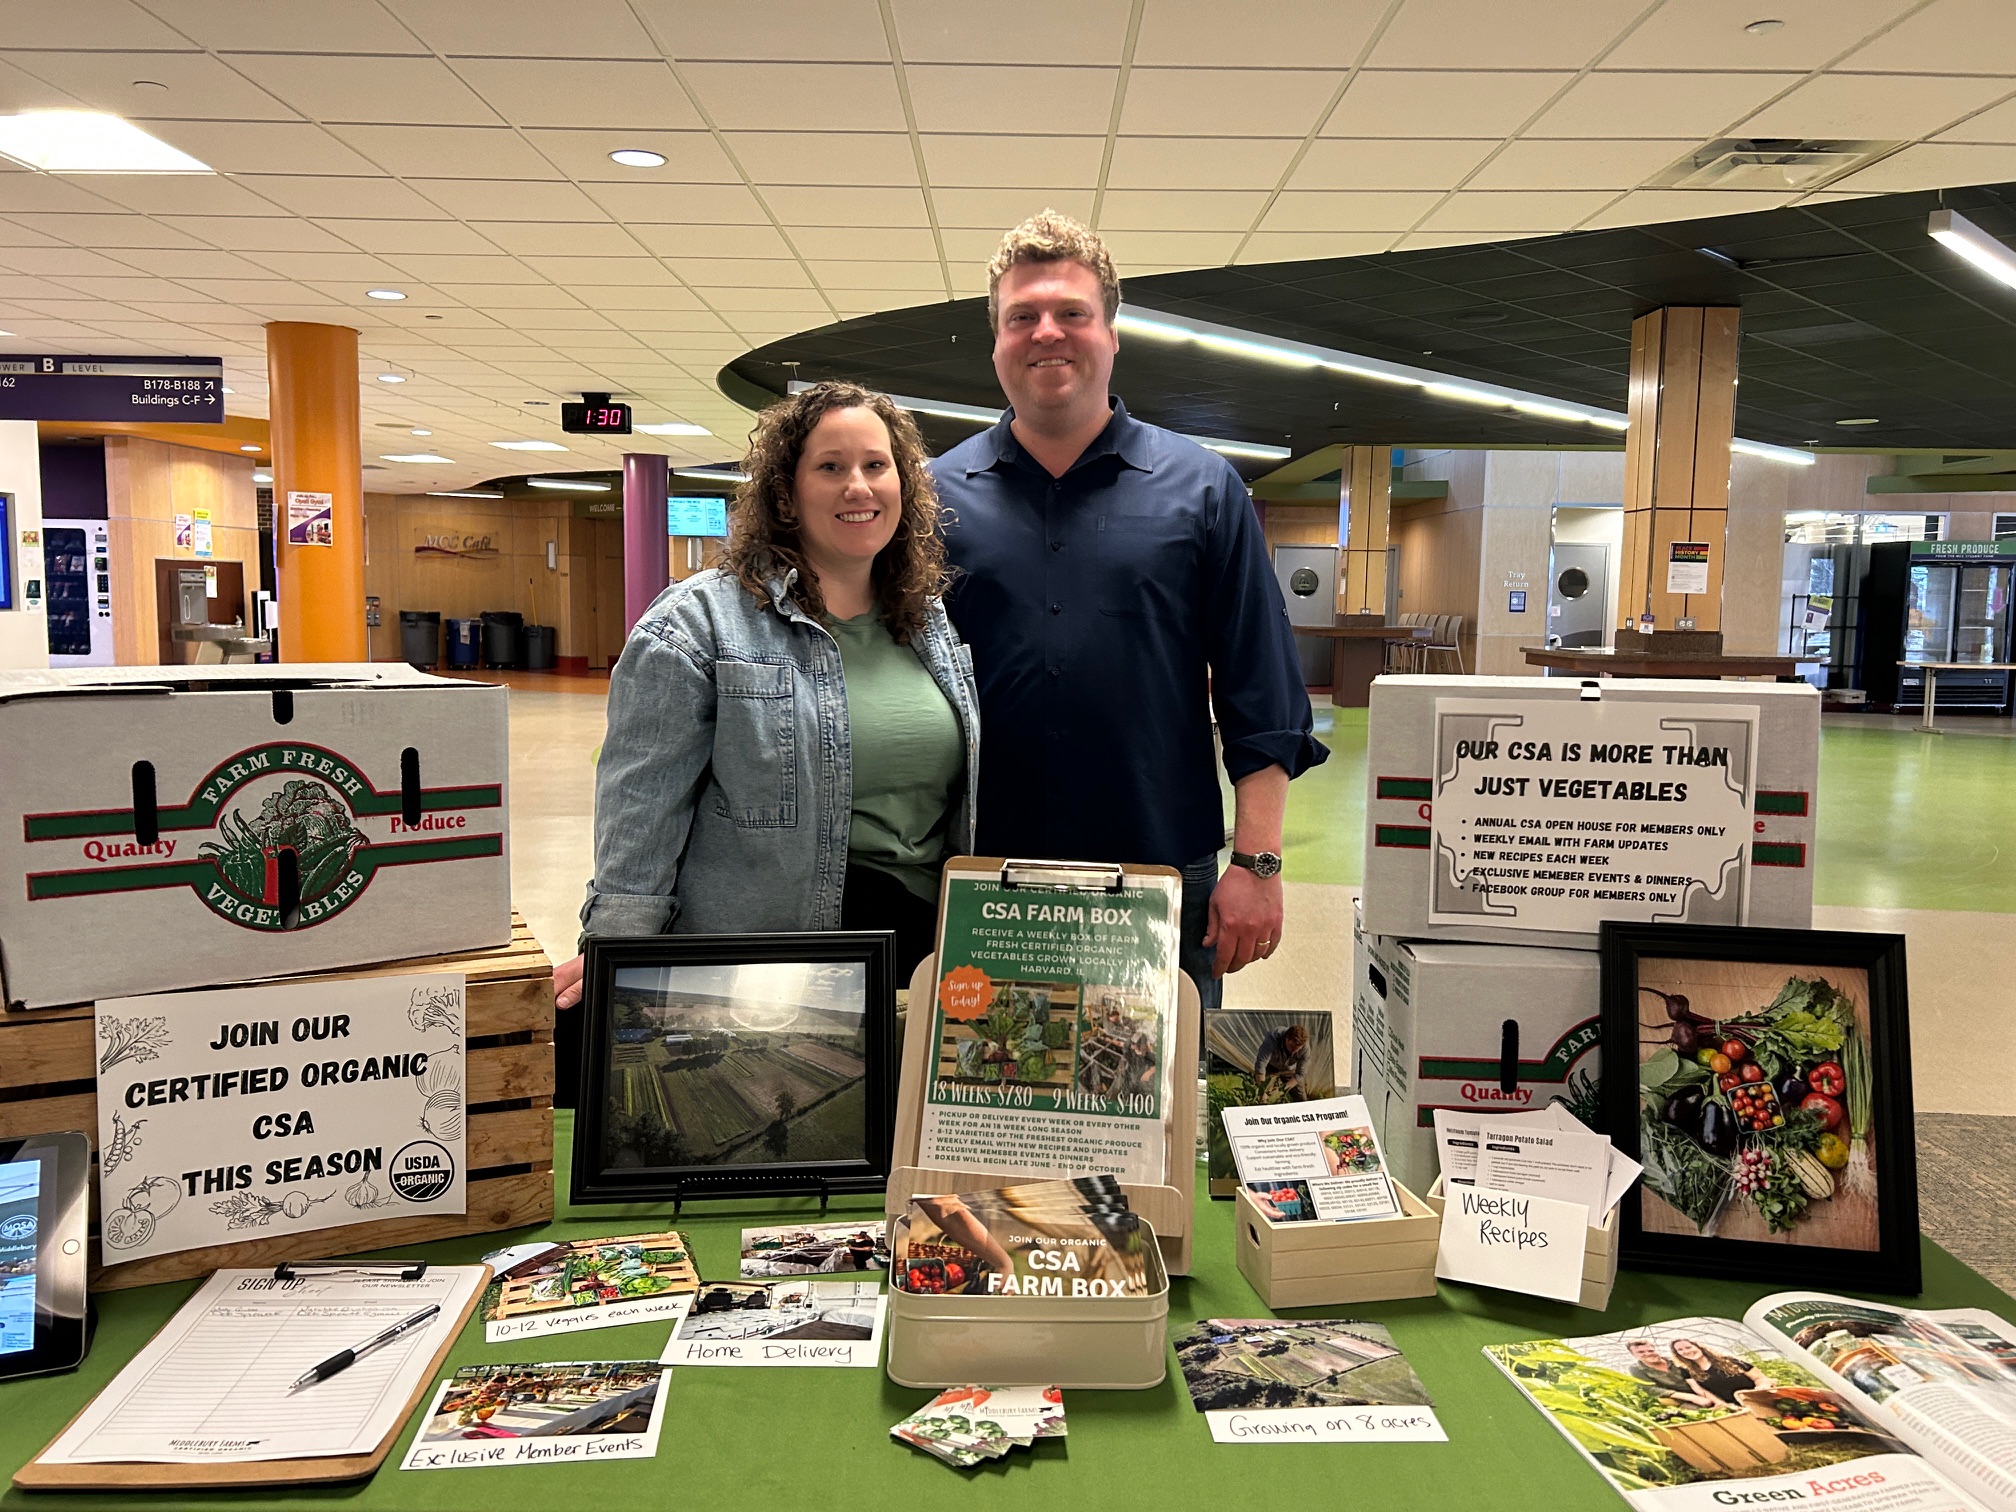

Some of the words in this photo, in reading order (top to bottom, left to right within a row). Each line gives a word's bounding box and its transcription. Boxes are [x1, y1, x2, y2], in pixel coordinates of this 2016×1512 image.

[43, 358, 54, 372] B
[144, 381, 200, 390] B178-B188
[132, 395, 179, 407] Buildings
[182, 396, 200, 405] C-F
[587, 409, 621, 425] 1:30
[589, 504, 615, 512] WELCOME
[424, 535, 459, 548] MCC
[463, 537, 491, 549] Café
[1931, 544, 1958, 553] FRESH
[1961, 544, 1999, 554] PRODUCE
[1508, 571, 1525, 580] Tray
[1456, 740, 1499, 759] OUR
[1508, 742, 1552, 761] CSA
[1561, 742, 1581, 761] IS
[1590, 744, 1653, 763] MORE
[1663, 746, 1728, 767] THAN
[201, 752, 271, 805] FARM
[282, 750, 362, 796] FRESH
[1474, 777, 1530, 796] JUST
[1539, 778, 1687, 801] VEGETABLES
[1475, 818, 1517, 827] ANNUAL
[1520, 819, 1541, 829] CSA
[1546, 821, 1573, 830] OPEN
[1577, 821, 1612, 831] HOUSE
[1615, 823, 1636, 832] FOR
[1641, 824, 1693, 835] MEMBERS
[1697, 826, 1726, 836] ONLY
[1474, 834, 1515, 844] WEEKLY
[1519, 836, 1550, 845] EMAIL
[1554, 838, 1580, 847] WITH
[1584, 839, 1614, 848] FARM
[1618, 840, 1668, 851] UPDATES
[1473, 851, 1495, 860] NEW
[1499, 852, 1543, 862] RECIPES
[1546, 854, 1576, 863] EACH
[1580, 855, 1609, 865] WEEK
[1472, 867, 1530, 878] EXCLUSIVE
[1533, 870, 1584, 881] MEMEBER
[1589, 873, 1630, 883] EVENTS
[1634, 875, 1642, 884] &
[1646, 875, 1692, 886] DINNERS
[974, 882, 999, 891] JOIN
[1472, 884, 1528, 895] FACEBOOK
[1531, 887, 1565, 897] GROUP
[1569, 889, 1589, 898] FOR
[1594, 890, 1645, 900] MEMBERS
[1649, 893, 1676, 902] ONLY
[982, 902, 1021, 920] CSA
[1027, 904, 1084, 923] FARM
[1091, 908, 1132, 925] BOX
[972, 928, 1013, 937] RECEIVE
[1027, 931, 1067, 940] WEEKLY
[1071, 933, 1090, 941] BOX
[1094, 934, 1107, 942] OF
[1111, 935, 1139, 945] FARM
[986, 940, 1019, 949] FRESH
[1021, 942, 1073, 952] CERTIFIED
[1076, 945, 1122, 955] ORGANIC
[971, 951, 1034, 961] VEGETABLES
[1037, 954, 1076, 963] GROWN
[1079, 957, 1124, 967] LOCALLY
[948, 981, 969, 992] Sign
[972, 981, 983, 992] up
[950, 994, 980, 1008] today!
[209, 1020, 280, 1050] JOIN
[291, 1014, 351, 1043] OUR
[124, 1065, 289, 1109] CERTIFIED
[300, 1052, 428, 1089] ORGANIC
[932, 1080, 947, 1101] 18
[1053, 1088, 1061, 1108] 9
[1117, 1090, 1154, 1115] $400
[252, 1110, 315, 1140] CSA
[1245, 1118, 1260, 1126] Join
[1274, 1115, 1300, 1125] Organic
[1301, 1114, 1315, 1122] CSA
[1316, 1110, 1348, 1121] Program!
[1067, 1137, 1102, 1145] ORGANIC
[1105, 1140, 1142, 1148] PRODUCE
[1487, 1132, 1513, 1142] Tarragon
[1515, 1135, 1535, 1144] Potato
[1536, 1138, 1553, 1146] Salad
[1092, 1148, 1128, 1156] UPDATES
[404, 1154, 441, 1171] USDA
[181, 1164, 253, 1197] THIS
[264, 1146, 383, 1185] SEASON
[400, 1171, 445, 1186] ORGANIC
[1463, 1193, 1529, 1227] Weekly
[4, 1221, 34, 1231] MOSA
[1009, 1234, 1033, 1244] JOIN
[1035, 1237, 1057, 1246] OUR
[1060, 1239, 1107, 1248] ORGANIC
[1480, 1220, 1548, 1250] Recipes
[1028, 1249, 1080, 1271] CSA
[237, 1278, 278, 1290] SIGN
[281, 1278, 306, 1290] UP
[987, 1273, 1068, 1297] FARM
[1072, 1278, 1127, 1297] BOX
[496, 1320, 539, 1337] 10-12
[545, 1311, 599, 1330] Veggies
[607, 1306, 640, 1320] each
[644, 1301, 684, 1315] week
[686, 1343, 743, 1360] Home
[763, 1345, 854, 1364] Delivery
[1229, 1414, 1318, 1437] Growing
[1326, 1418, 1352, 1431] on
[1356, 1414, 1375, 1430] 8
[1381, 1415, 1431, 1429] acres
[409, 1447, 505, 1468] Exclusive
[516, 1443, 582, 1460] Member
[585, 1438, 643, 1455] Events
[1713, 1488, 1806, 1505] Green
[1806, 1471, 1886, 1497] Acres
